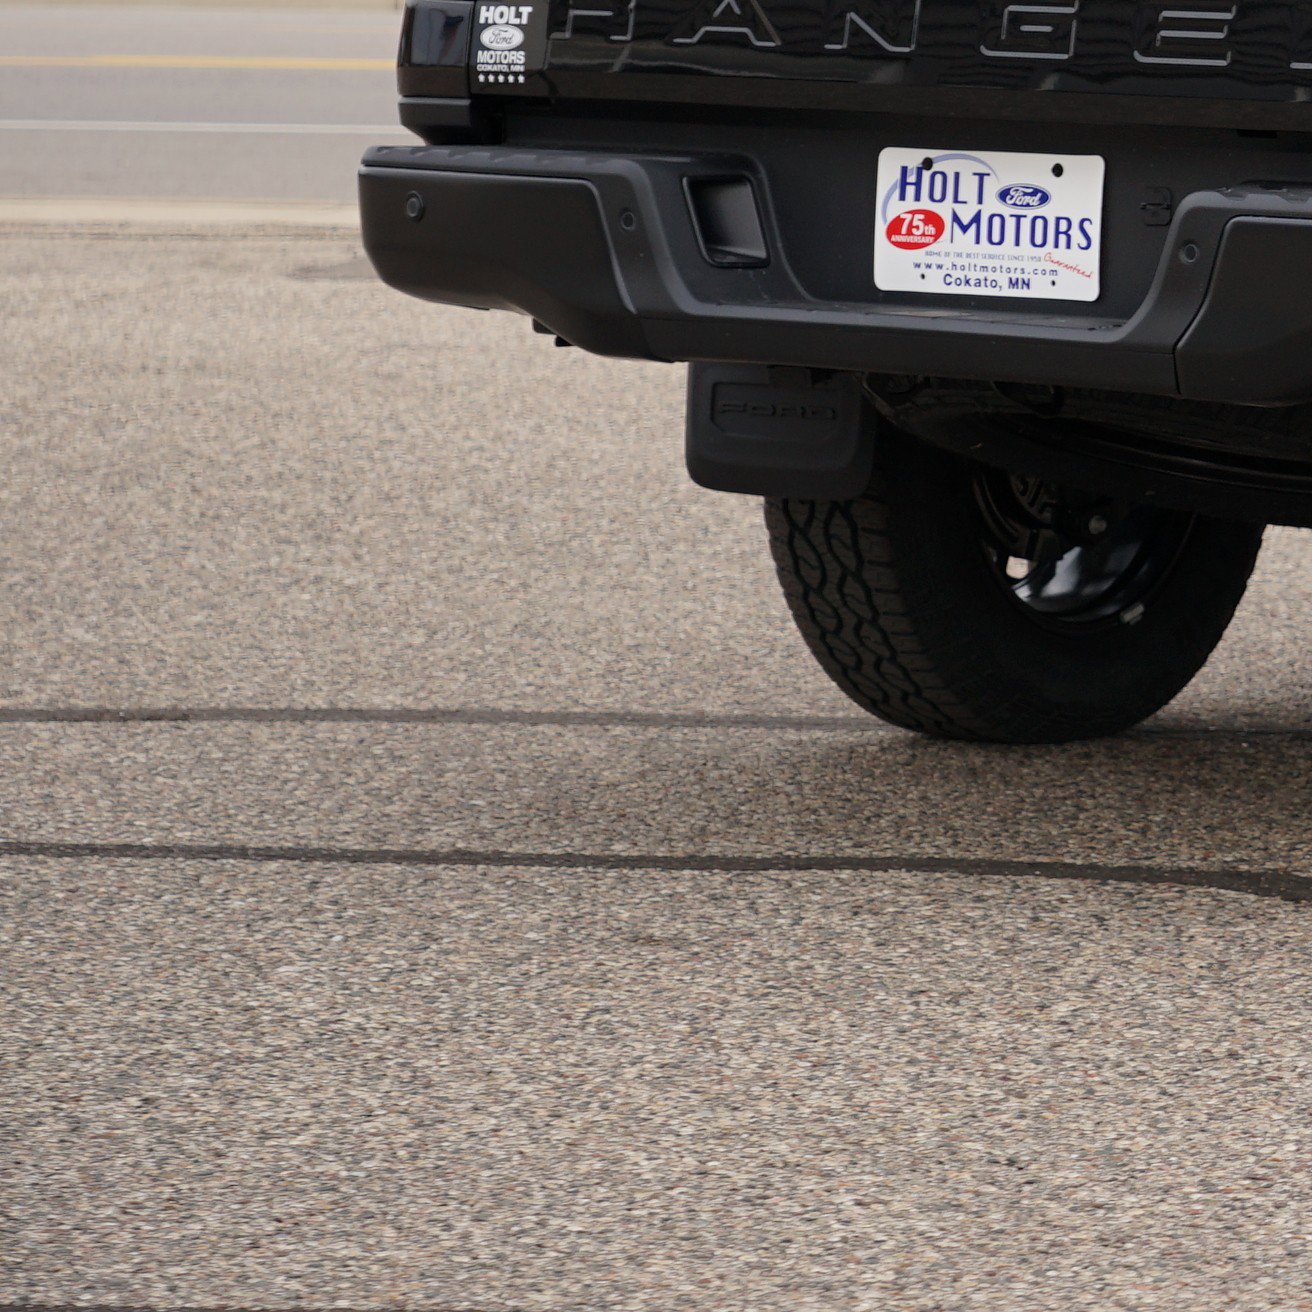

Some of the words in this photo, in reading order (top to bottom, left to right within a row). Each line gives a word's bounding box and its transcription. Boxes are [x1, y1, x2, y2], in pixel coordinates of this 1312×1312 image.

[478, 5, 533, 25] HOLT
[488, 29, 514, 45] Ford
[476, 50, 526, 64] MOTORS
[898, 165, 991, 205] HOLT
[1005, 187, 1042, 206] Ford
[899, 213, 936, 236] 75th
[950, 208, 1093, 251] MOTORS
[890, 234, 935, 244] ANNIVERSARY
[912, 261, 1059, 277] www.holtmotors.com
[943, 274, 1002, 292] Cokato,
[1008, 277, 1031, 290] MN
